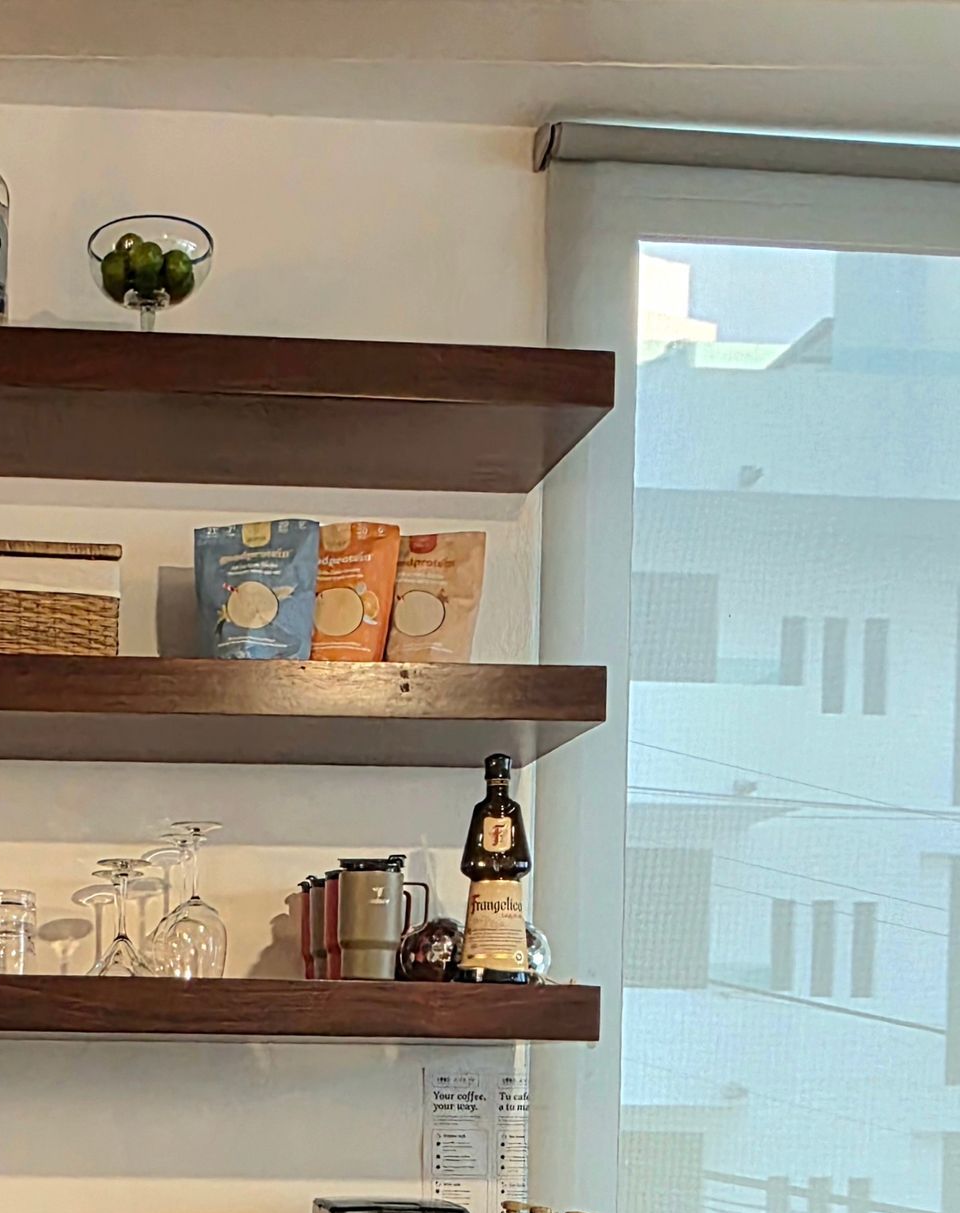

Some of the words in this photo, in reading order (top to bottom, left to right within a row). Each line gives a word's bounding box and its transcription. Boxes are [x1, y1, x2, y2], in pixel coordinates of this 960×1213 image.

[471, 894, 523, 915] Frangelico
[433, 1091, 455, 1100] Your
[457, 1091, 487, 1103] coffee,
[433, 1103, 454, 1113] your
